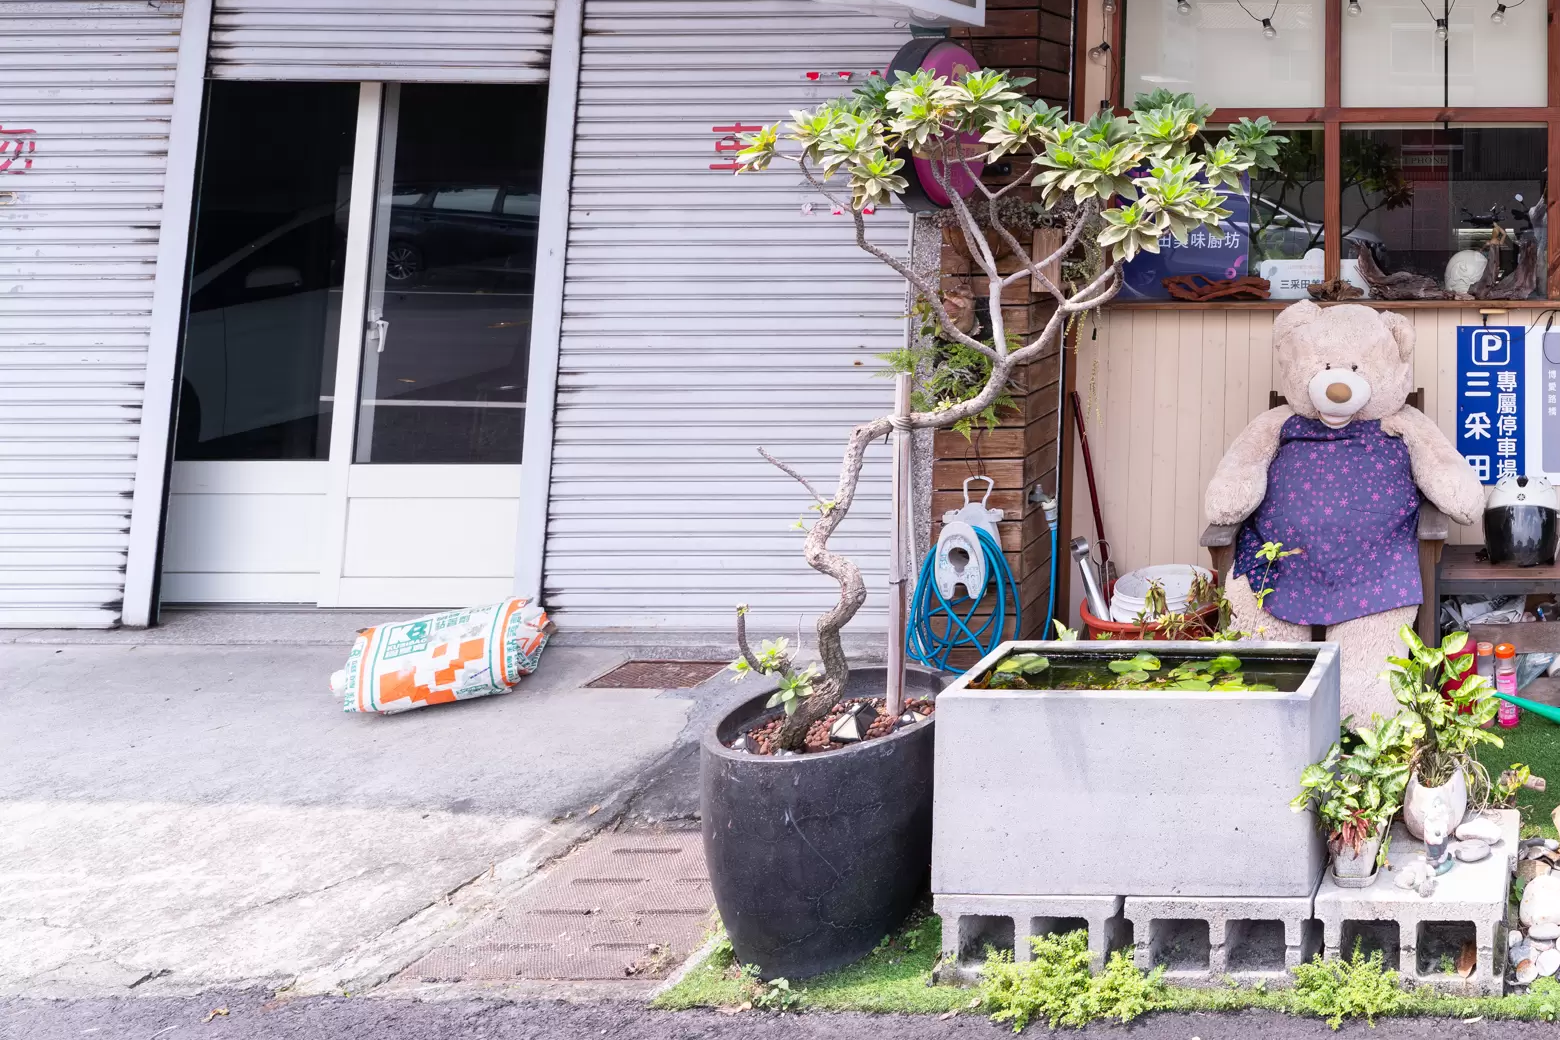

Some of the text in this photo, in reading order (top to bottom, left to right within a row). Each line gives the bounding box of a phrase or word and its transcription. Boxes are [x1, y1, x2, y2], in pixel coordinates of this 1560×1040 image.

[1482, 334, 1503, 361] P
[1496, 370, 1518, 479] 專屬停車場
